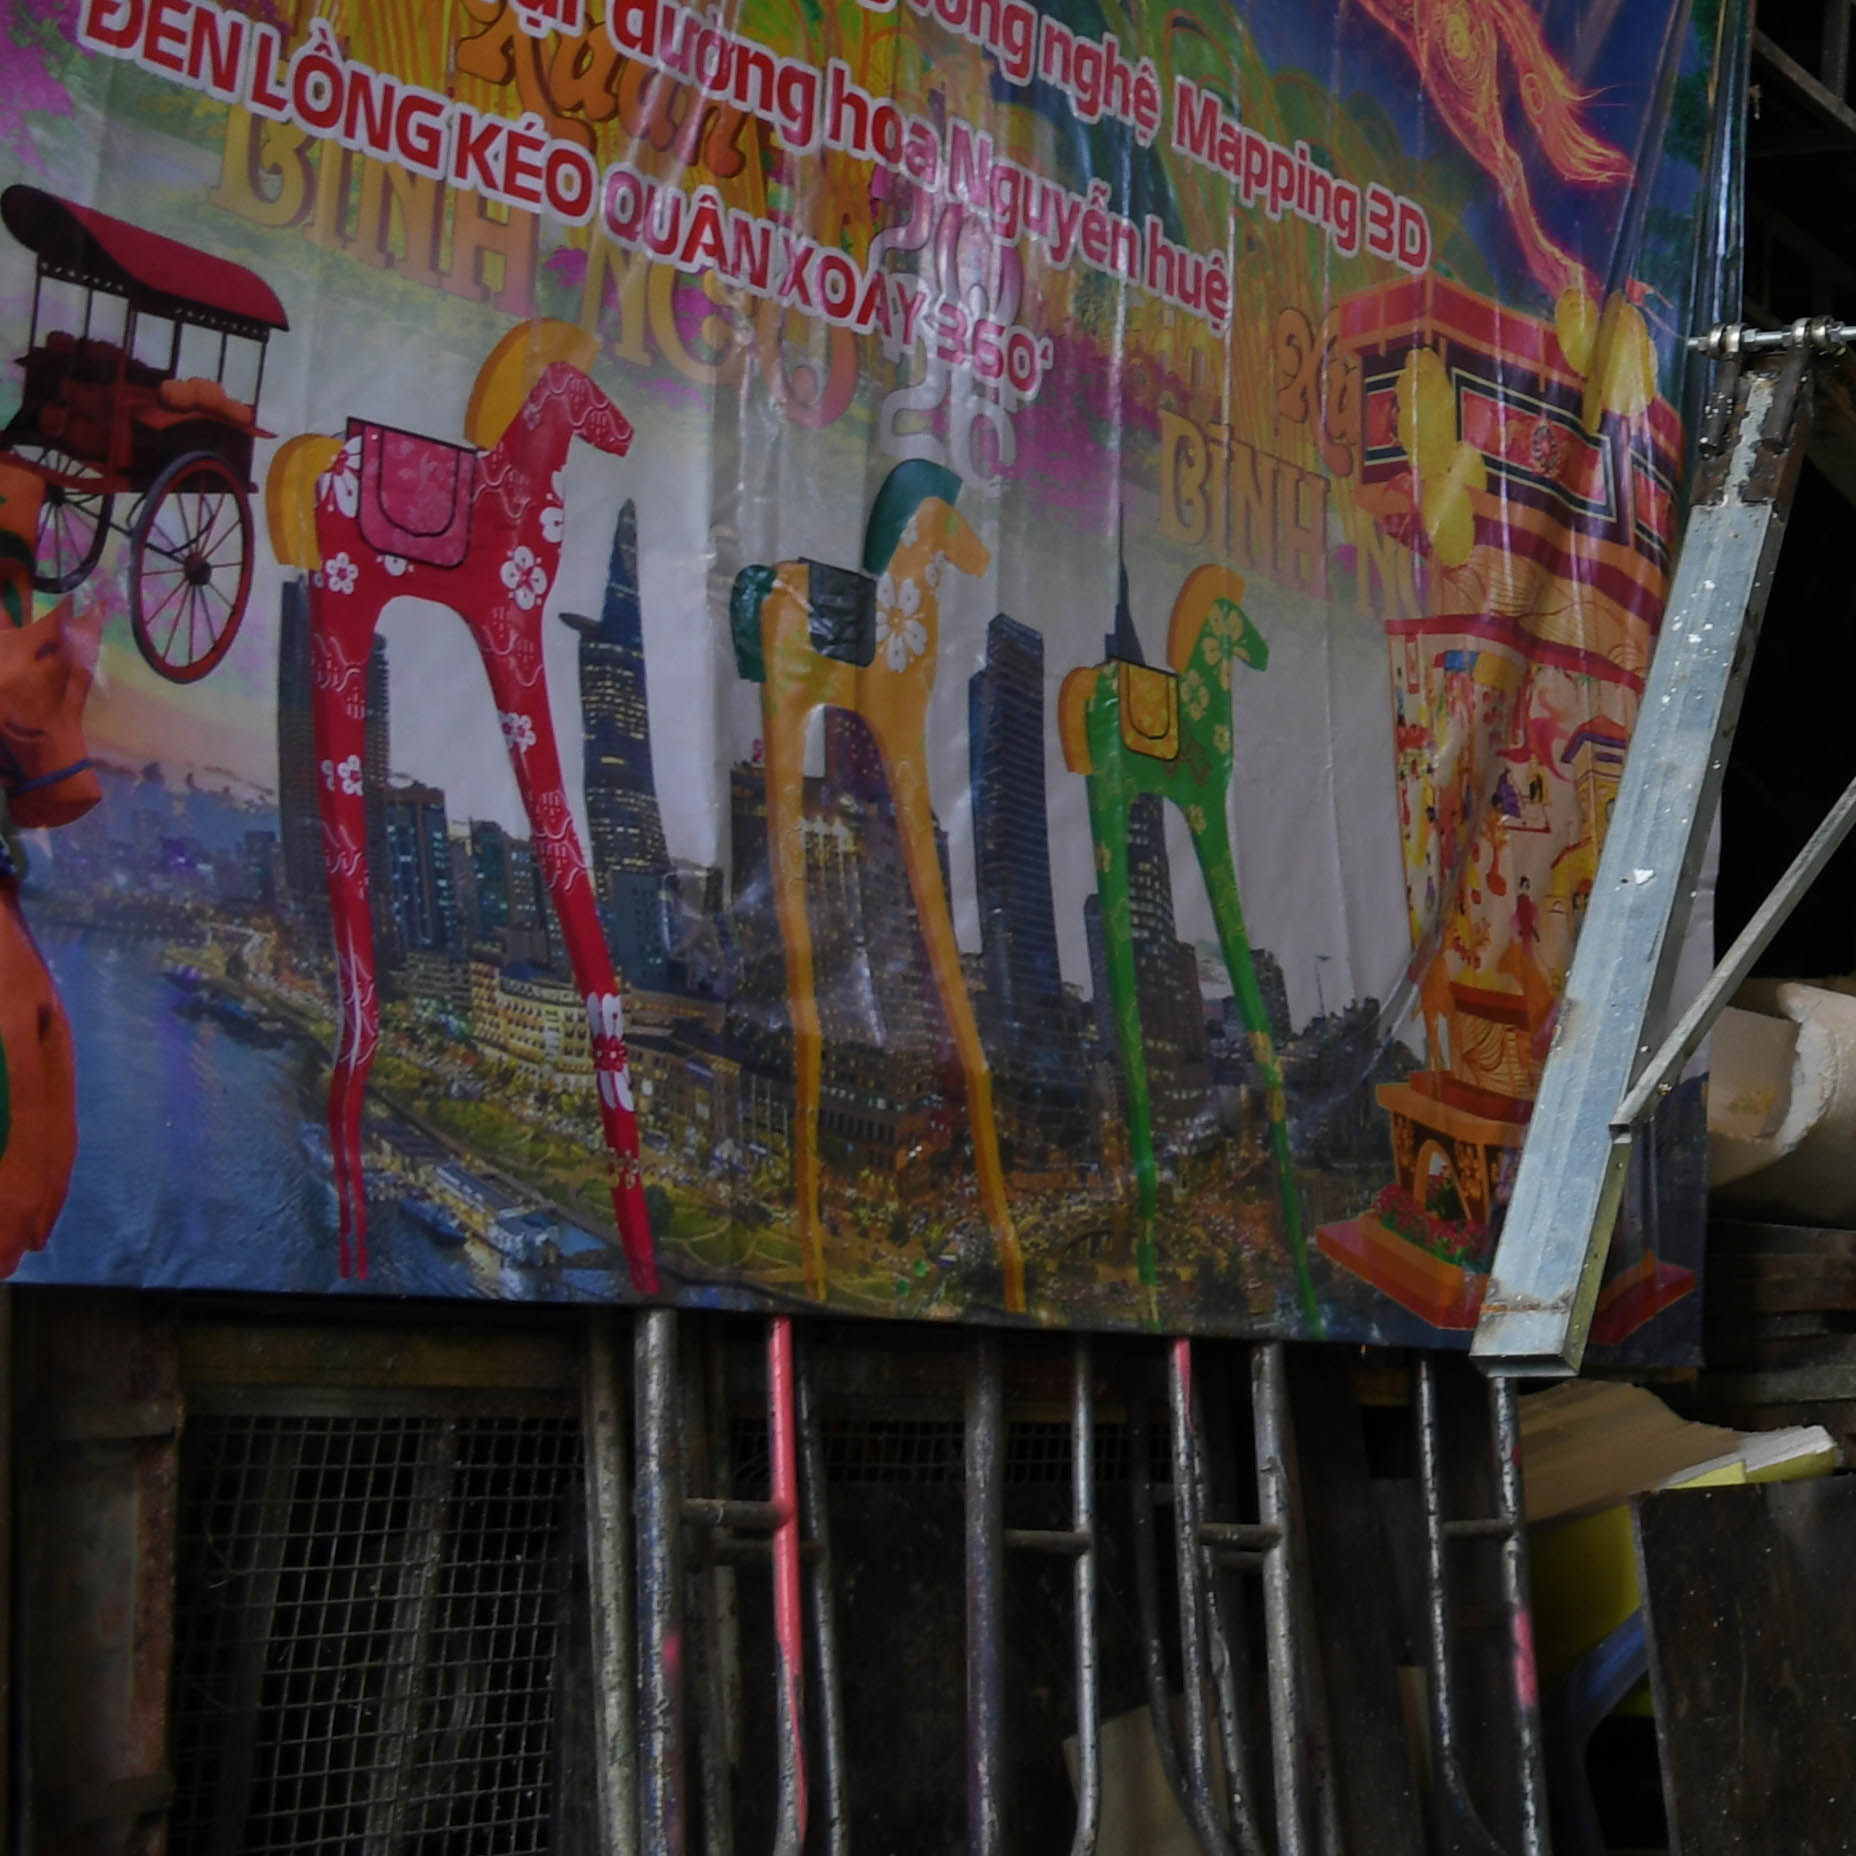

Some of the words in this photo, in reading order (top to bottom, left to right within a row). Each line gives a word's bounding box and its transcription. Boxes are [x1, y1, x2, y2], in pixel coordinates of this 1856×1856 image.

[244, 15, 453, 181] LỒNG
[447, 100, 598, 227] KÉO
[605, 162, 773, 297] QUÂN
[770, 229, 938, 350] XOAY
[820, 57, 940, 192] hoa
[946, 119, 1144, 286] Nguyễn
[1141, 214, 1235, 337] huệ
[1038, 17, 1162, 148] nghệ
[1171, 74, 1361, 258] Mapping
[1364, 183, 1432, 274] 3D
